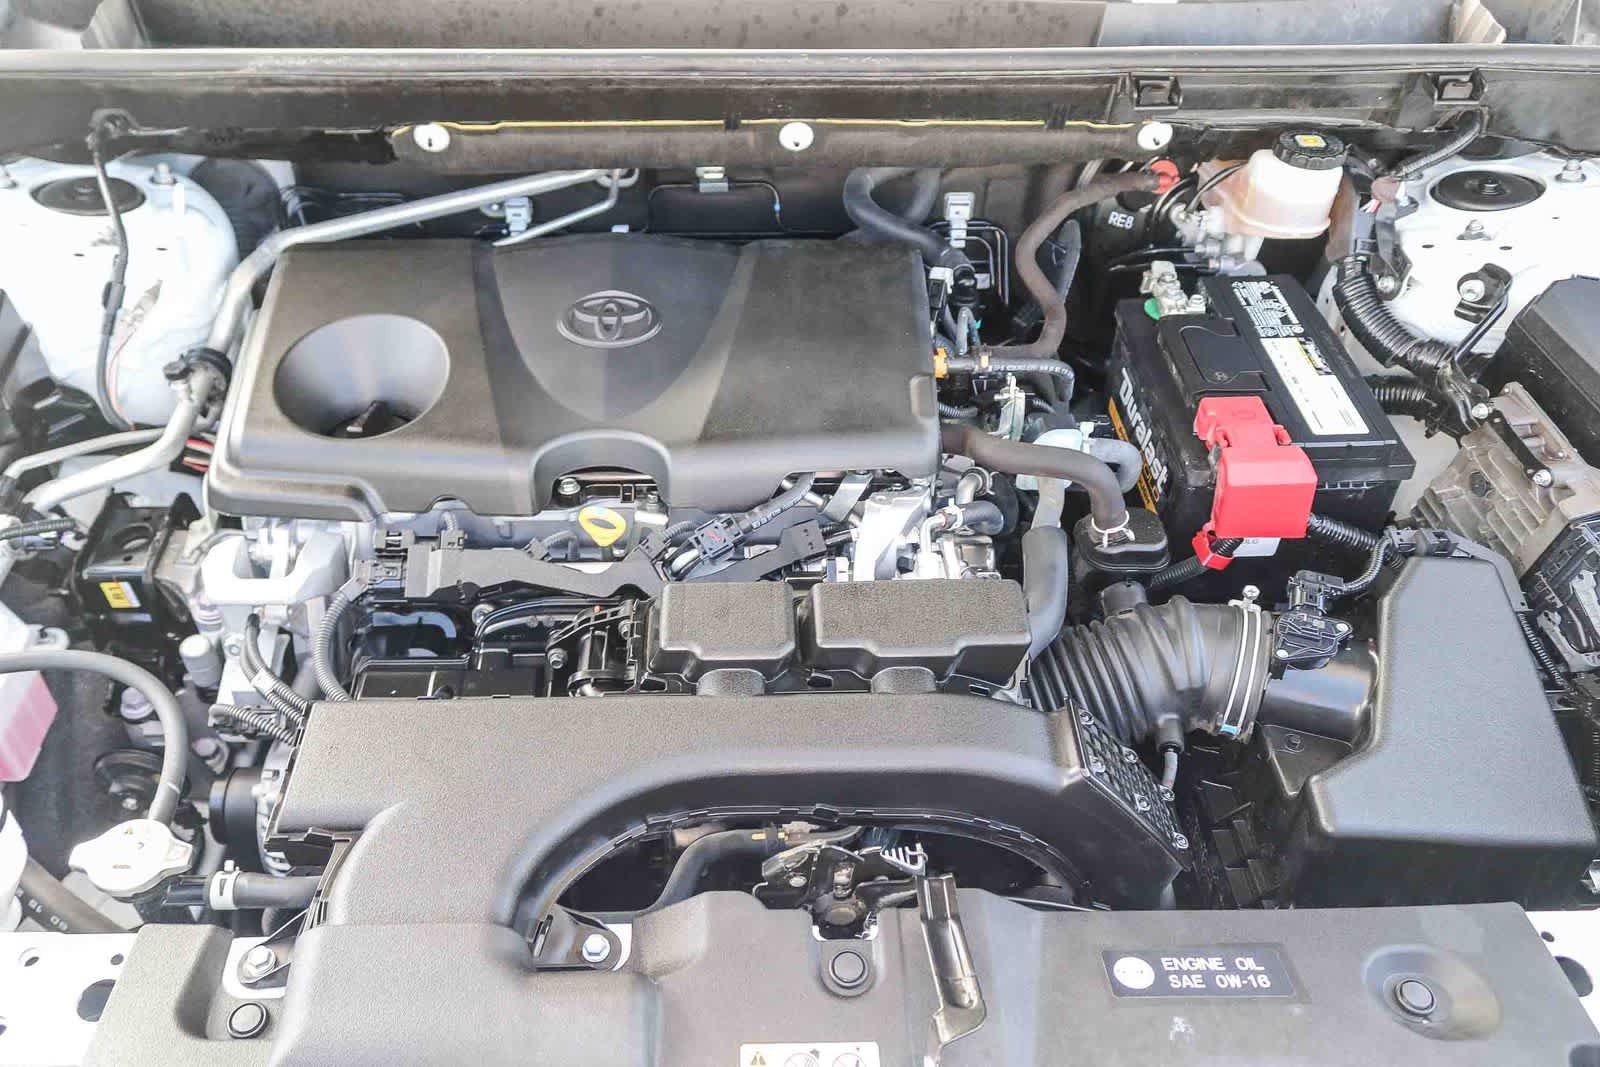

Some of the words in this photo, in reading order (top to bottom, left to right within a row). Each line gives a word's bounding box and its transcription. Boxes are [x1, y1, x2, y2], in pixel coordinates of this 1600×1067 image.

[1119, 367, 1169, 493] Duralast
[1160, 957, 1226, 971] ENGINE
[1235, 957, 1265, 971] OIL
[1169, 974, 1206, 989] SAE
